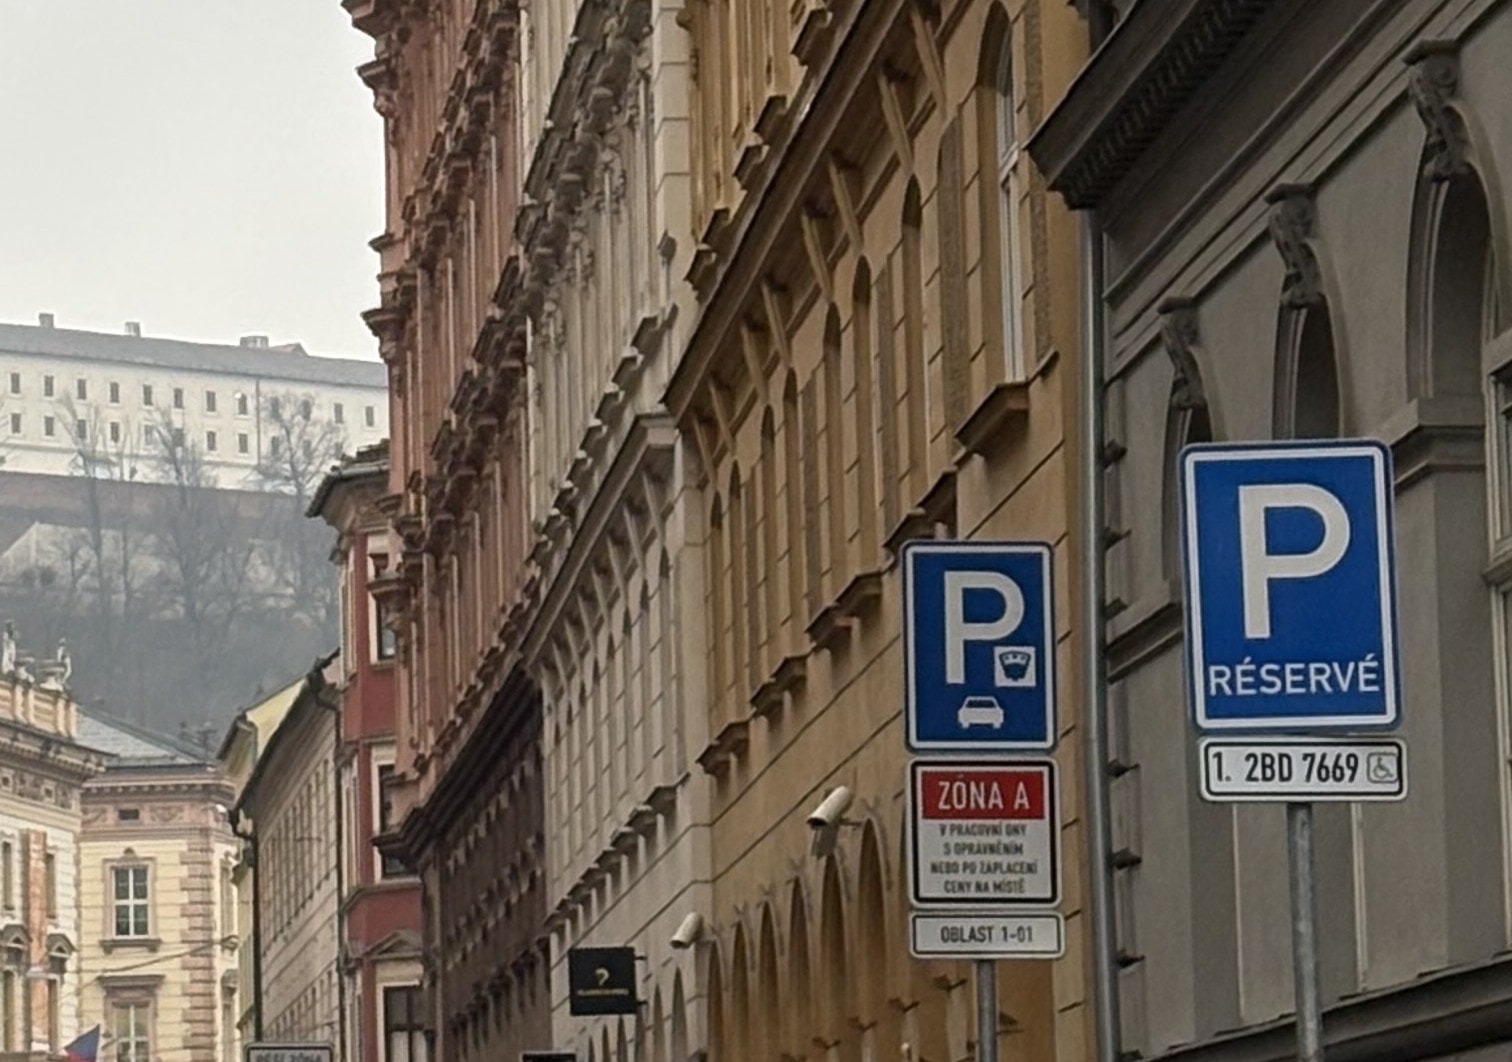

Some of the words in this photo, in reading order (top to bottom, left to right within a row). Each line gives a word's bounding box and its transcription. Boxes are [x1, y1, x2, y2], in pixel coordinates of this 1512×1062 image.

[1238, 483, 1351, 640] P
[943, 570, 1025, 685] P
[1208, 653, 1380, 696] RÉSERVÉ
[1212, 751, 1232, 782] 1.
[1244, 752, 1293, 783] 2BD
[1302, 752, 1359, 783] 7669
[938, 774, 1004, 810] ZÓNA
[1014, 781, 1030, 810] A
[931, 861, 959, 874] NEBO
[962, 861, 977, 874] PO
[944, 880, 971, 894] CENY
[975, 880, 989, 894] NA
[941, 926, 994, 943] OBLAST
[1001, 926, 1033, 943] 1-01
